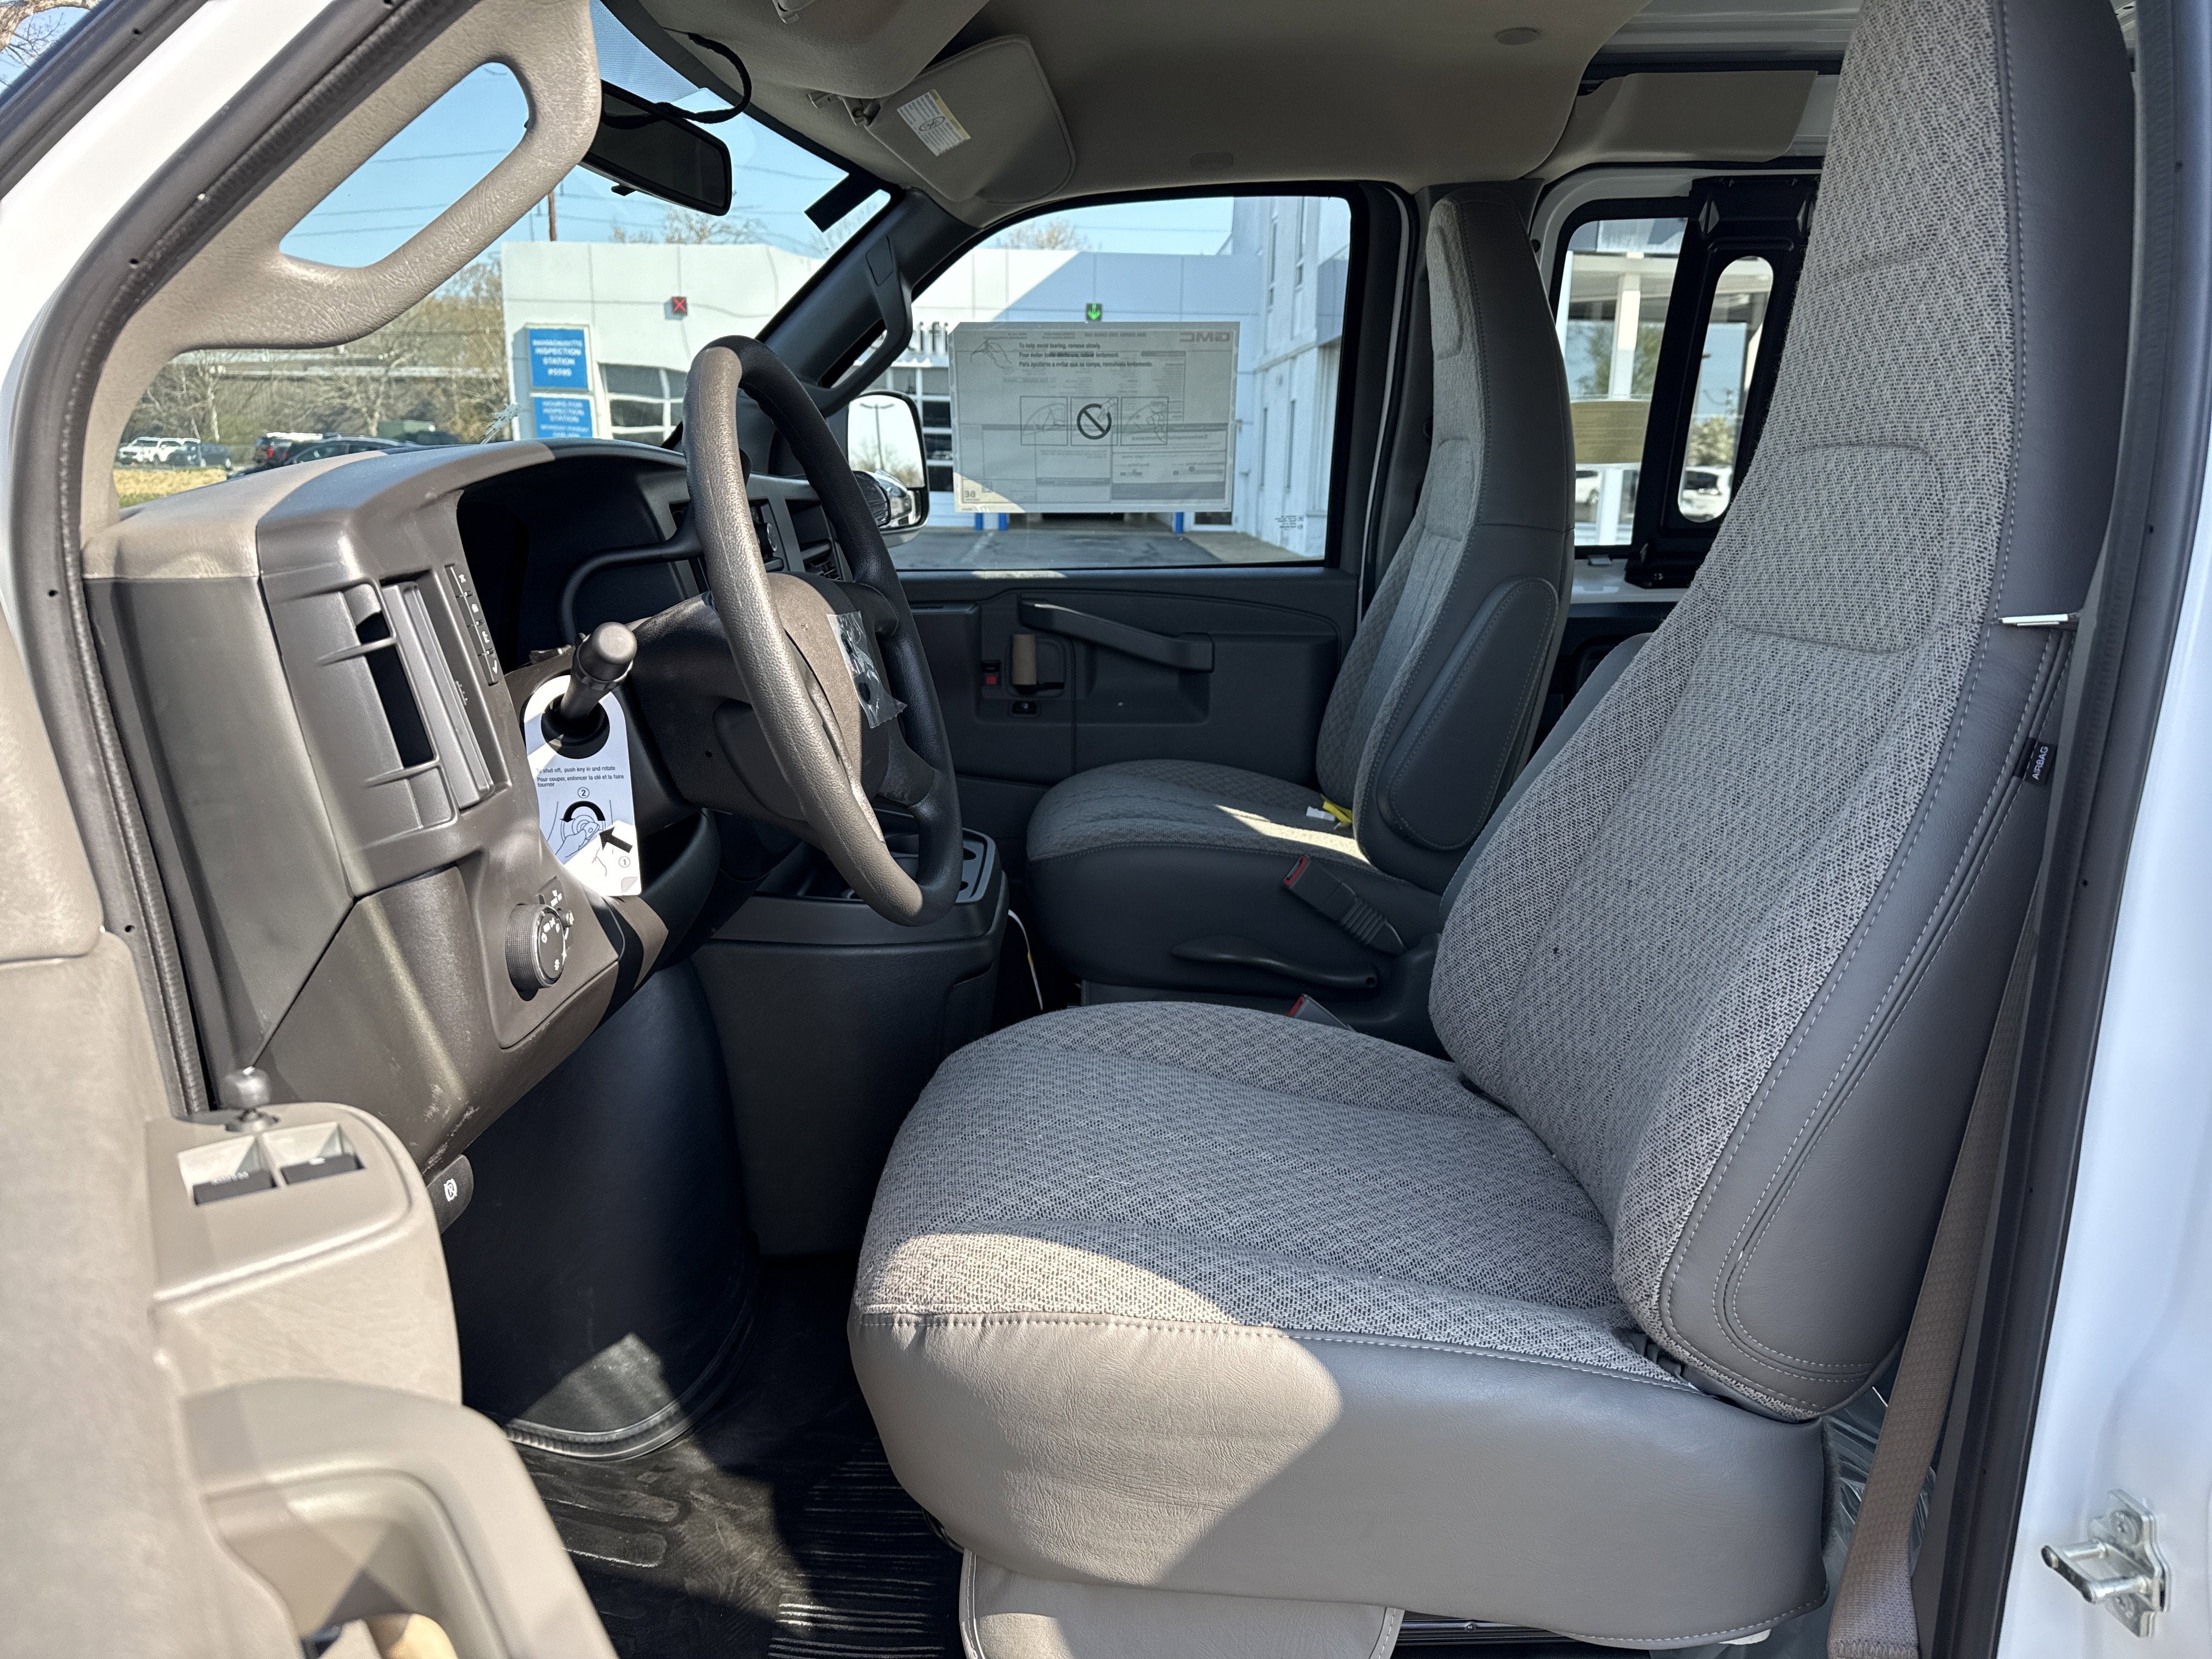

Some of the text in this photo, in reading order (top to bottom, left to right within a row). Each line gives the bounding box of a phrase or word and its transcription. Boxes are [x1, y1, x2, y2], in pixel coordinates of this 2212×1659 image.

[535, 347, 582, 356] INSPECTION
[542, 357, 575, 365] STATION
[2032, 746, 2049, 780] AIRBAG
